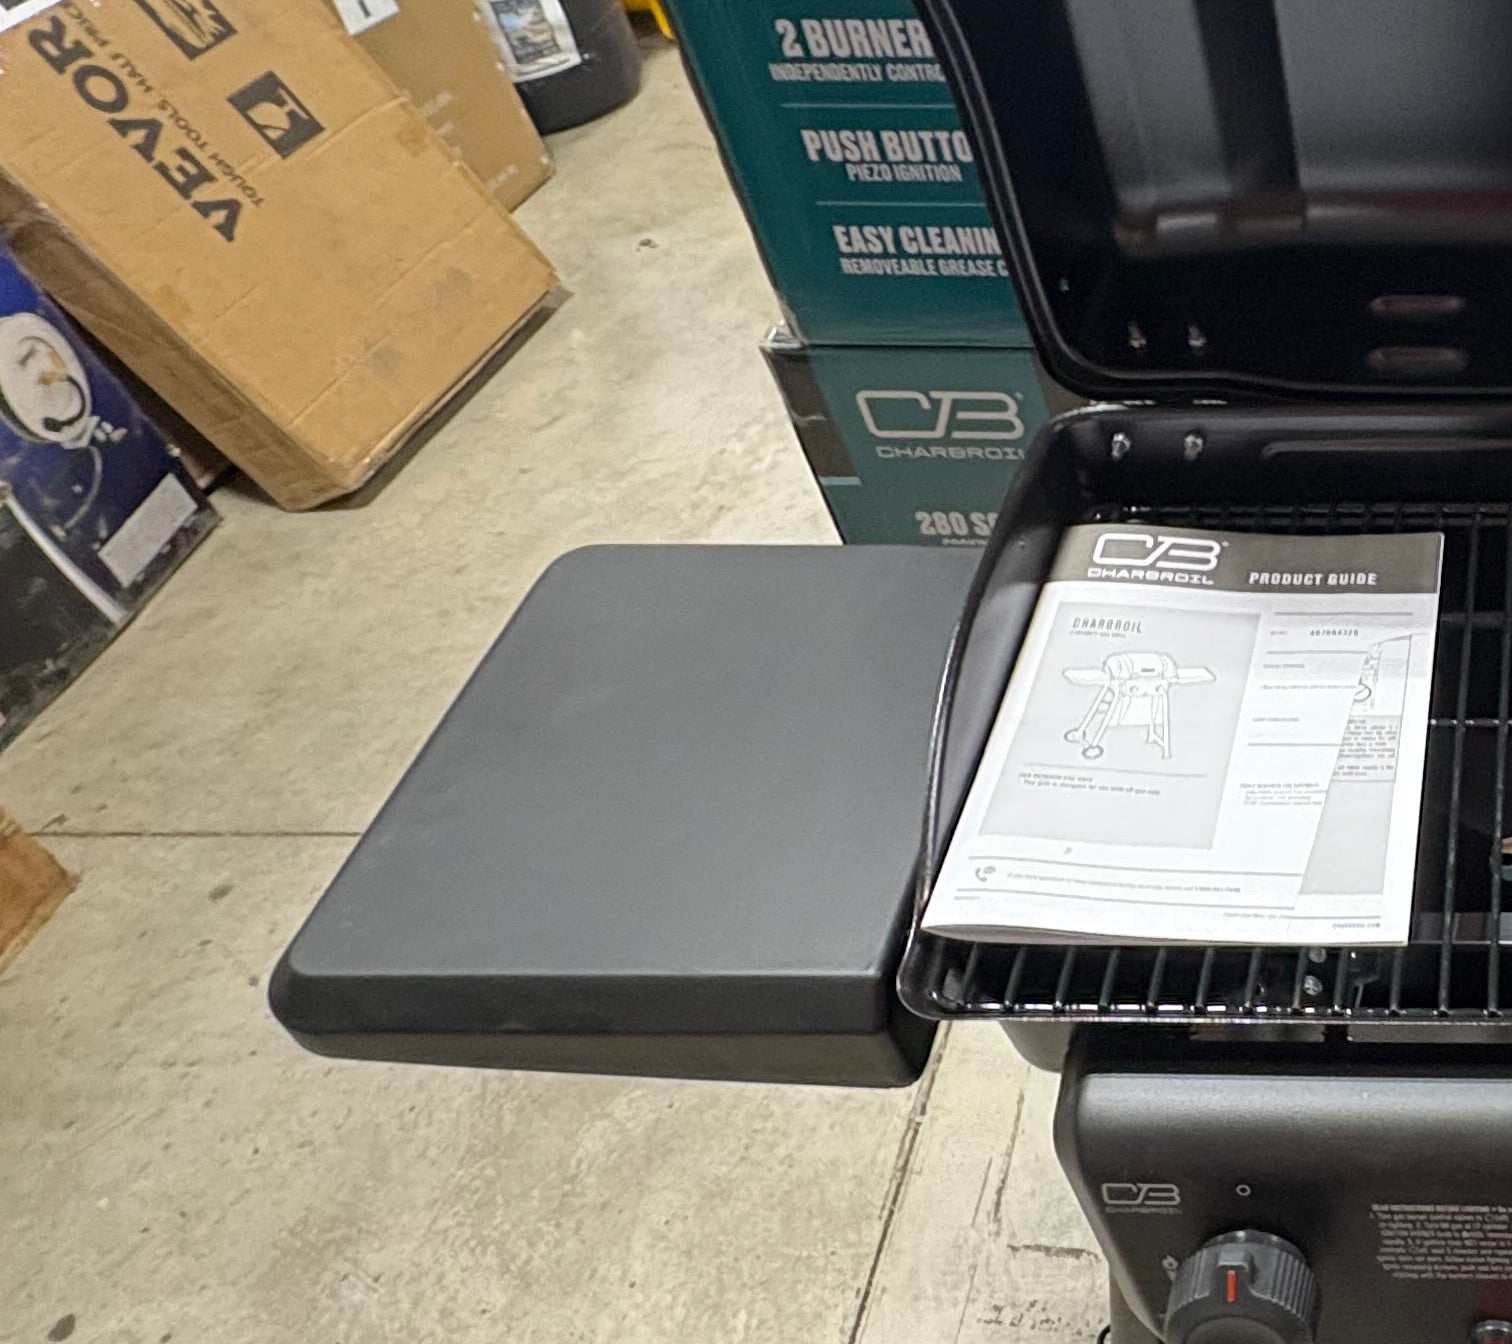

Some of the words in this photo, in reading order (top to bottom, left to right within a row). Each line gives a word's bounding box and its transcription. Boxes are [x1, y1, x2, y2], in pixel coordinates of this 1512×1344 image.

[62, 0, 110, 48] PRIC
[774, 18, 804, 57] 2
[801, 18, 937, 58] BURNER
[768, 62, 884, 82] INDEPENDENTLY
[884, 63, 947, 83] CONTRO
[28, 15, 243, 243] VEVOR
[801, 129, 882, 162] PUSH
[879, 130, 975, 163] BUTTO
[208, 151, 266, 209] TOUGH
[846, 162, 893, 182] PIEZO
[893, 163, 963, 183] IGNITION
[832, 224, 897, 254] EASY
[899, 225, 1003, 256] CLEANIN
[840, 257, 940, 276] REMOVEABLE
[937, 258, 995, 277] GREASE
[914, 510, 970, 537] 280
[1087, 567, 1214, 586] CHARBROIL
[1249, 571, 1323, 586] PRODUCT
[1326, 571, 1379, 586] GUIDE
[1072, 617, 1143, 635] CHARBROIL
